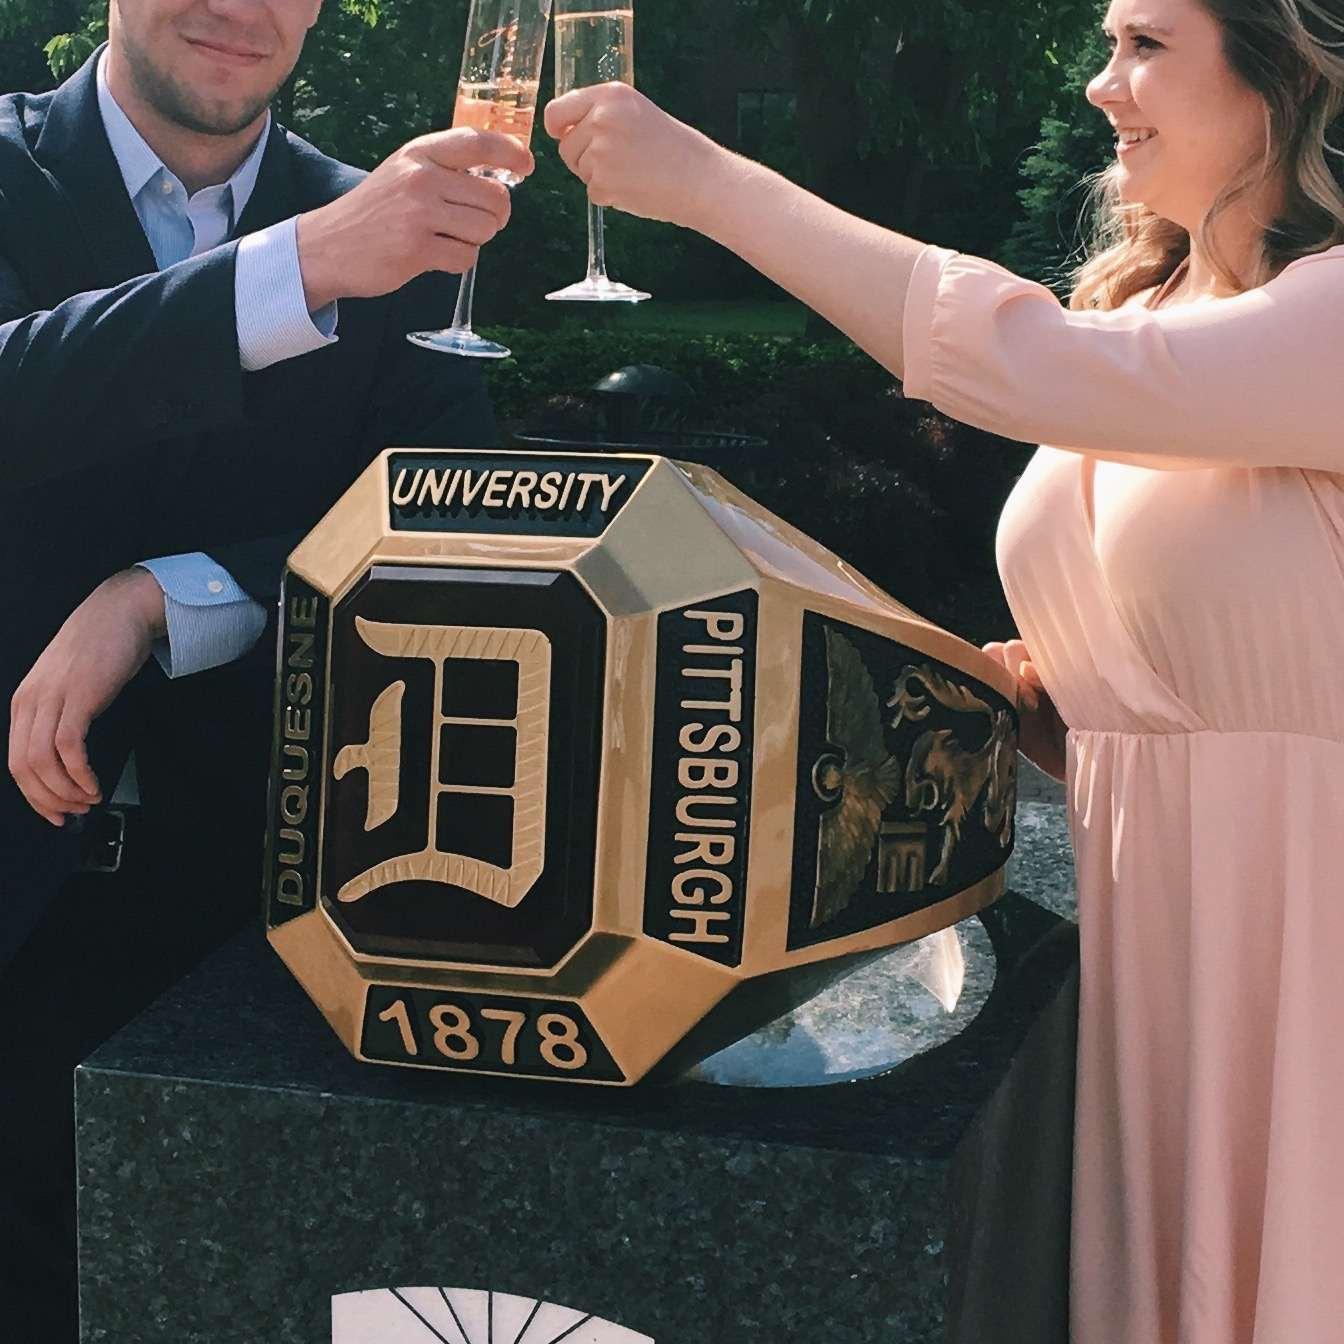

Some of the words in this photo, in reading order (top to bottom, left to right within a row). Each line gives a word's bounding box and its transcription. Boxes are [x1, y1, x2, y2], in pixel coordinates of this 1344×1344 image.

[392, 468, 626, 511] UNIVERSITY
[276, 596, 318, 905] DUQUESNE
[668, 610, 744, 943] PITTSBURGH
[378, 1000, 588, 1069] 1878
